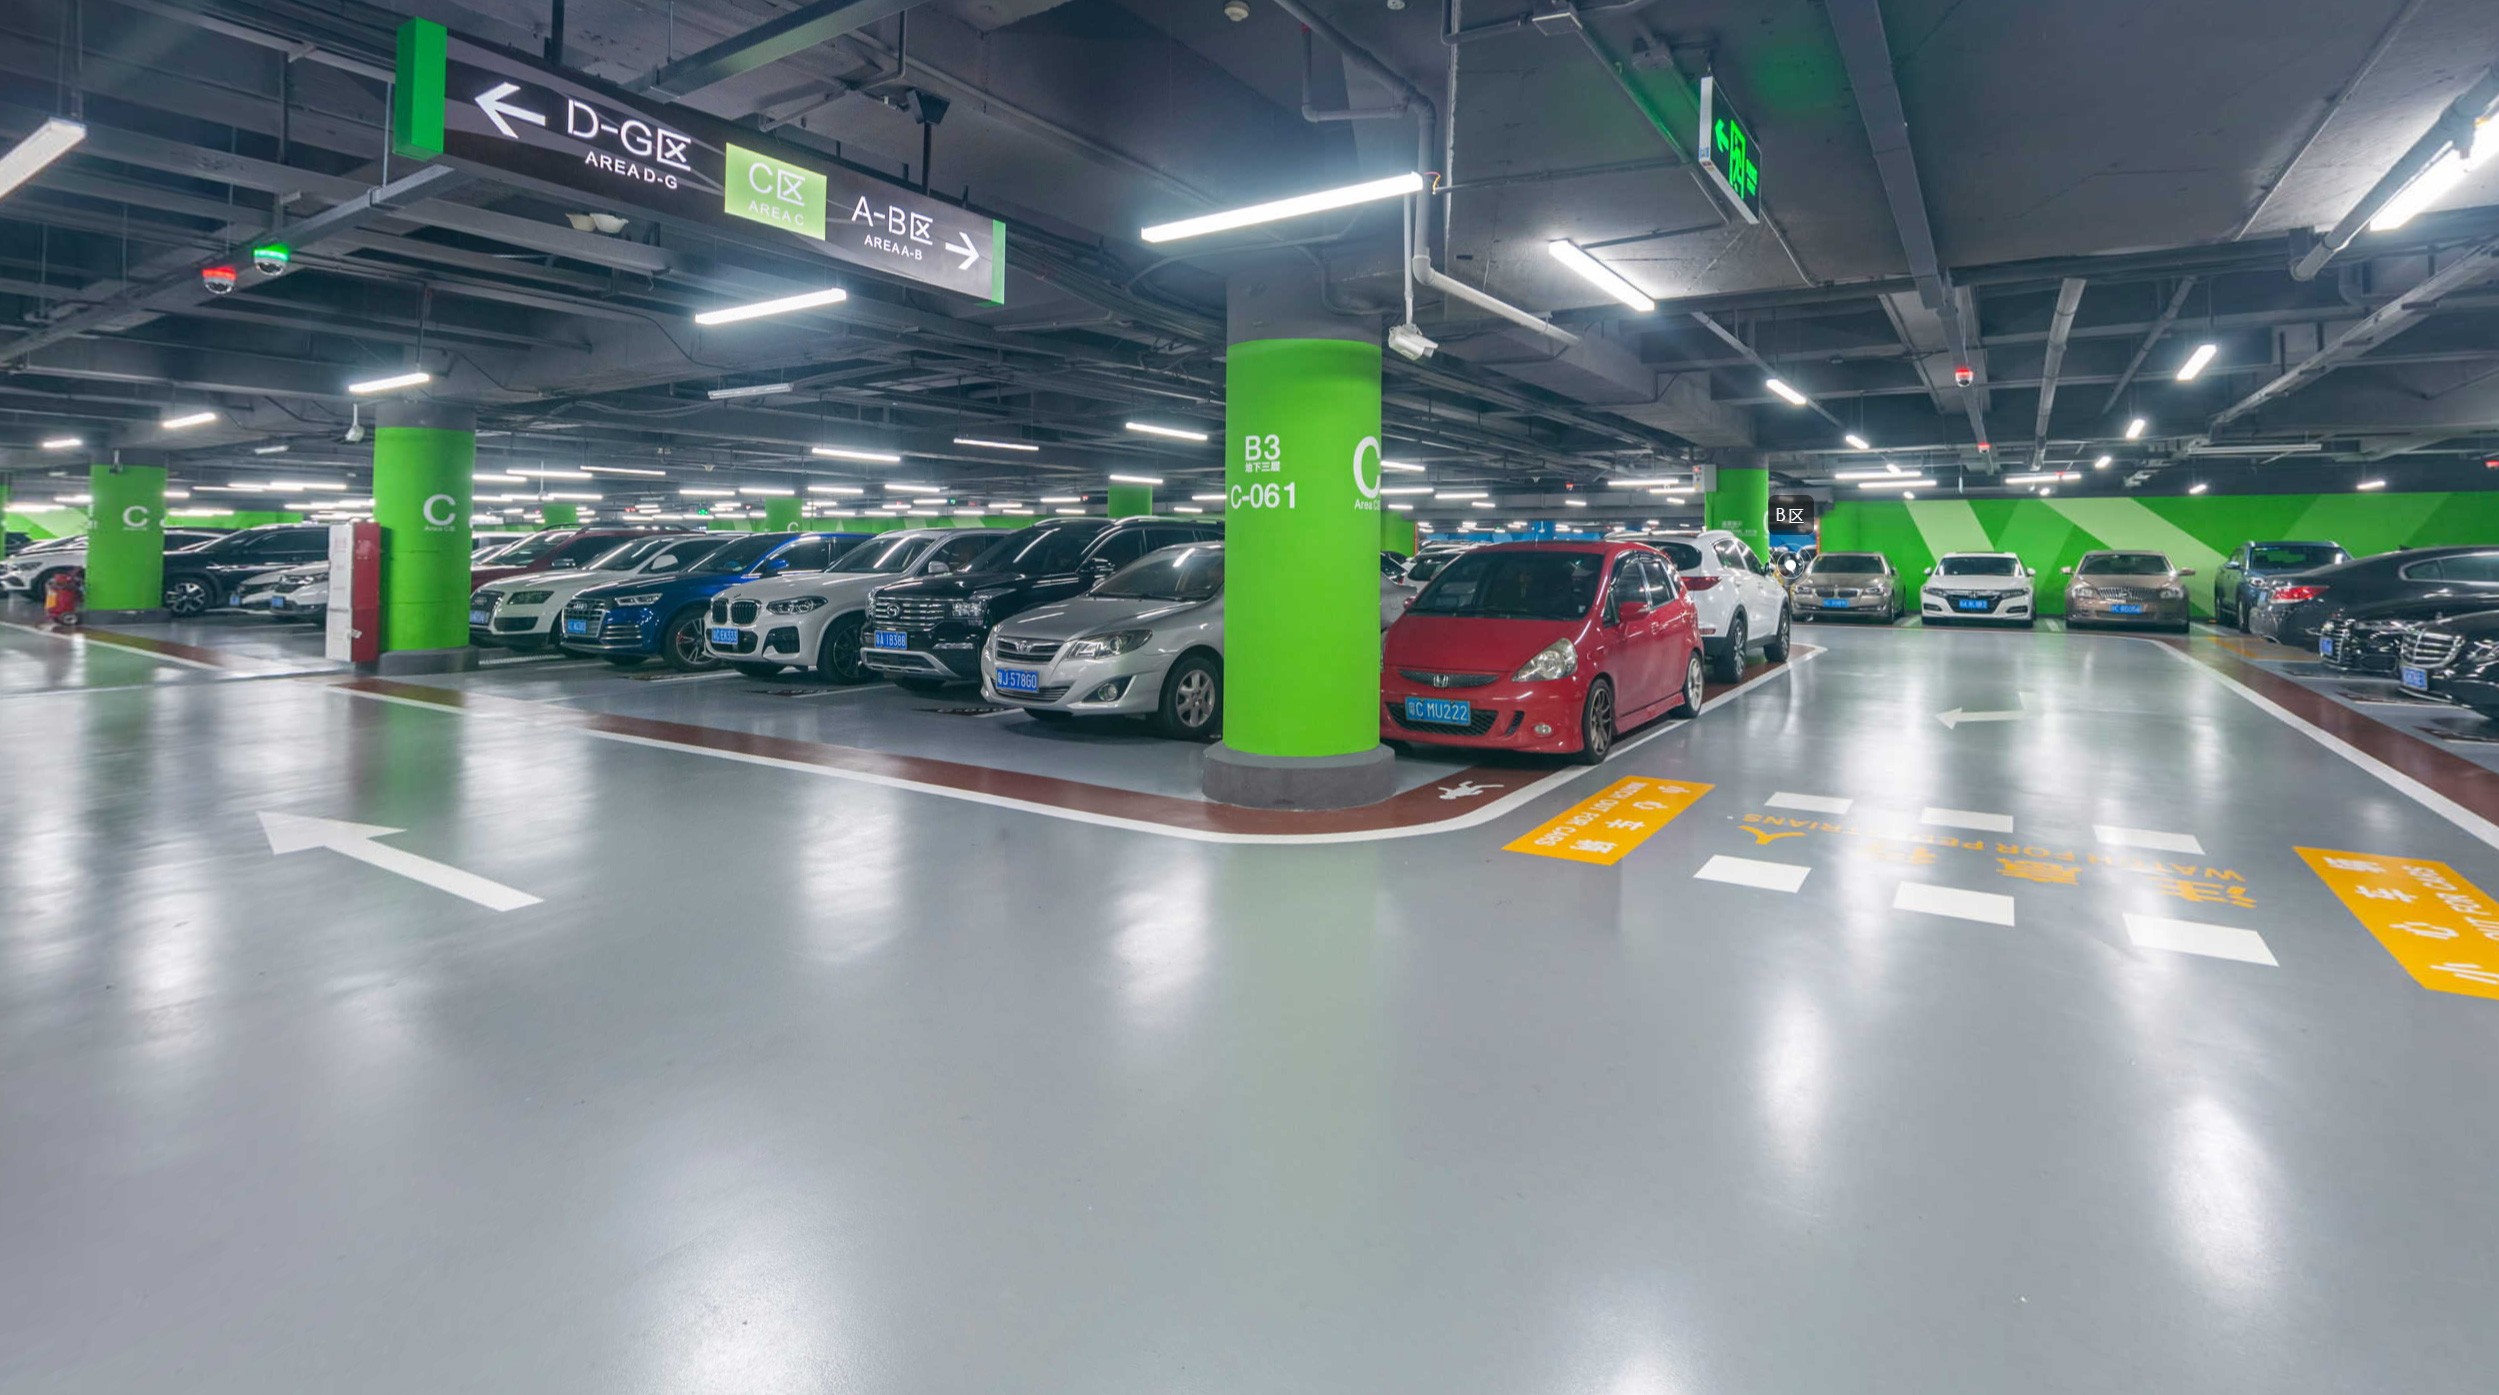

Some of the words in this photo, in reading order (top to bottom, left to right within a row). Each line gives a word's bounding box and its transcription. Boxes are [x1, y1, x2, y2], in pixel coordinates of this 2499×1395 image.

[567, 99, 692, 172] D-G区
[584, 150, 641, 180] AREA
[643, 167, 678, 190] D-G
[748, 162, 806, 207] C区
[748, 199, 792, 225] AREA
[794, 213, 804, 227] C
[851, 195, 934, 246] A-B区
[863, 233, 900, 256] AREA
[901, 244, 923, 261] A-B
[1245, 434, 1281, 461] B3
[1353, 436, 1381, 499] C
[423, 493, 456, 526] C
[1230, 481, 1296, 510] C-061
[123, 505, 149, 527] C
[1996, 842, 2075, 862] FOR
